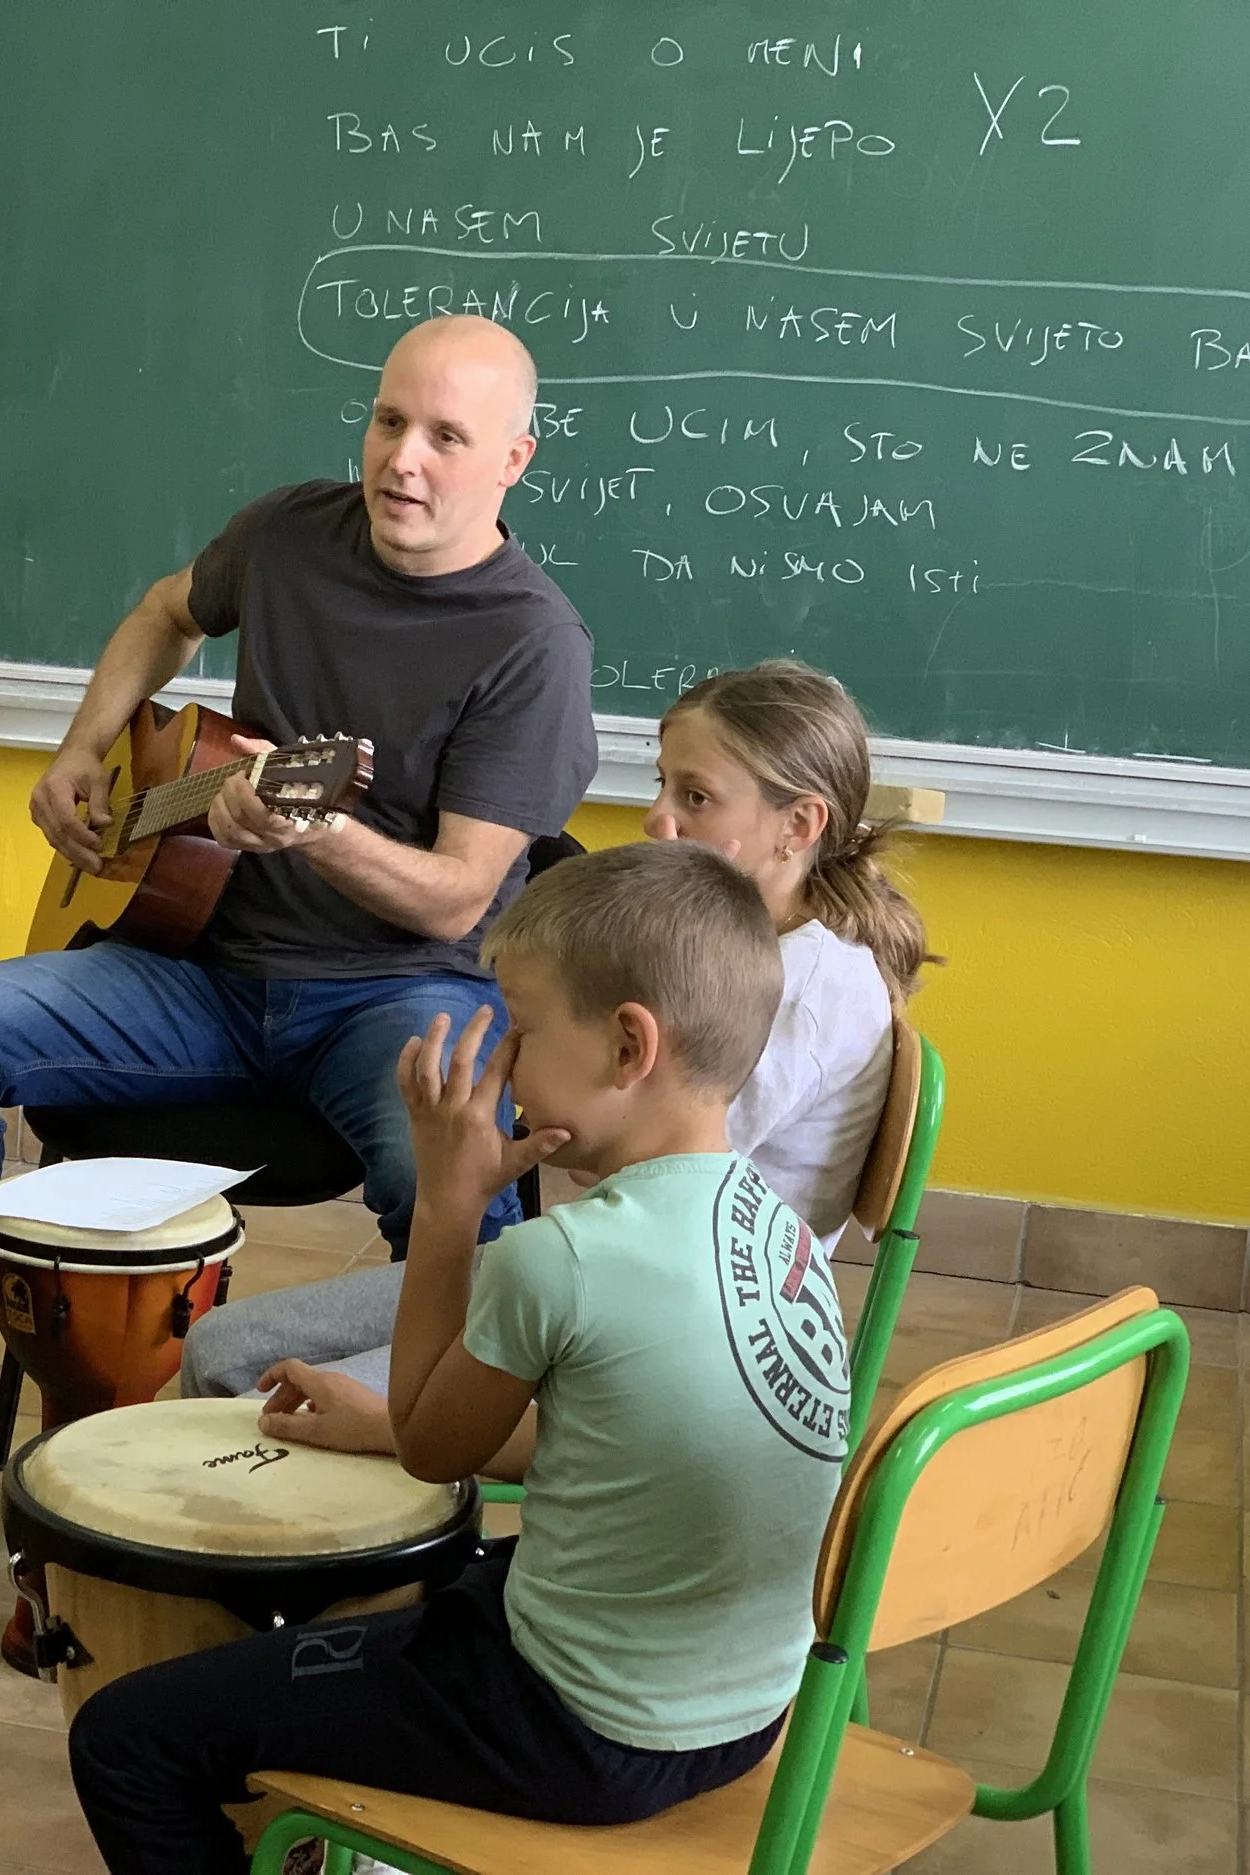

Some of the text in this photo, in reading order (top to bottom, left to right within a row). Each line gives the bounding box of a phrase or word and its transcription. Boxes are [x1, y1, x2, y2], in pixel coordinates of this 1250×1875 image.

[651, 37, 684, 67] O
[327, 112, 438, 153] BAS
[492, 121, 586, 156] NAM
[629, 125, 670, 179] JE
[745, 304, 897, 348] NASEM
[957, 314, 1123, 366] SVIJETO
[845, 422, 922, 463] STO
[973, 437, 1031, 470] NE
[1071, 430, 1236, 476] ZNAM
[705, 484, 936, 529] OSVAJAM
[632, 549, 693, 581] DA
[778, 1221, 797, 1267] ALWAYS
[730, 1237, 760, 1307] THE
[748, 1317, 834, 1438] ETERNAL
